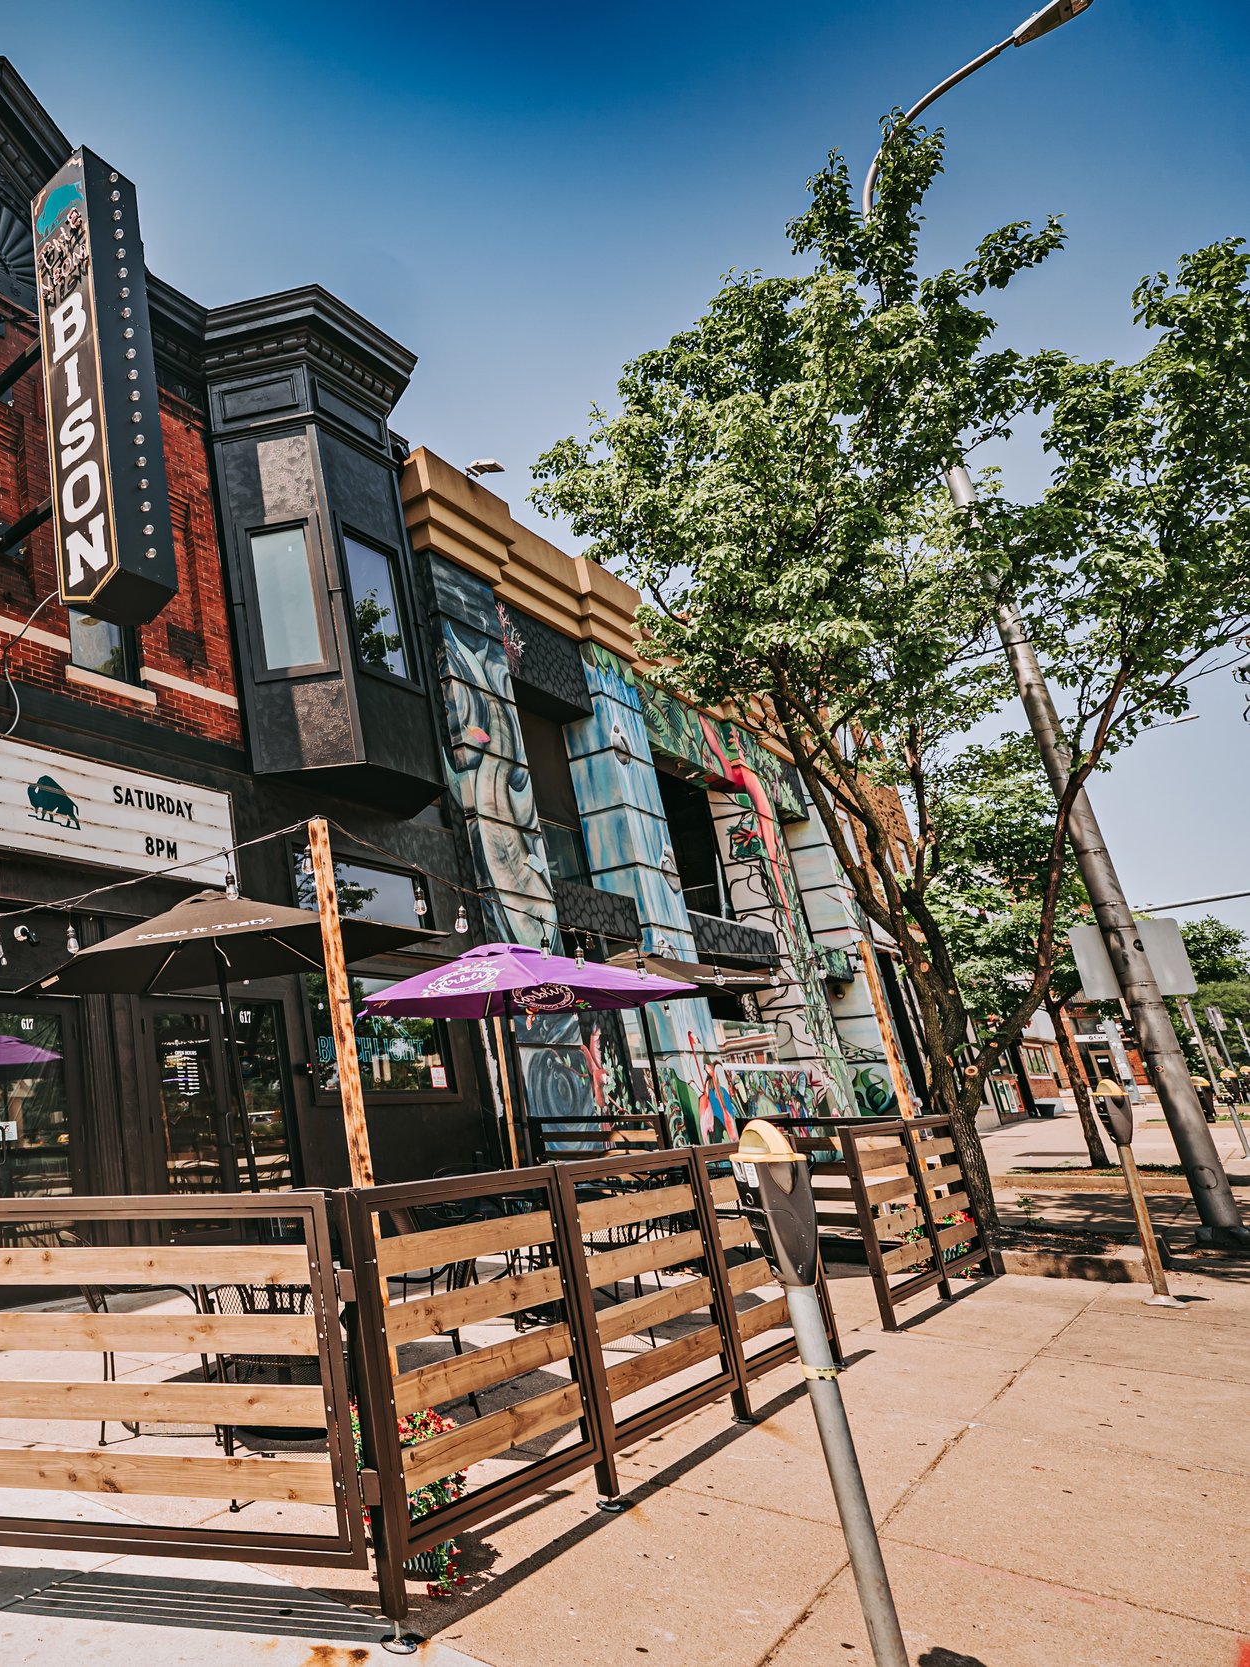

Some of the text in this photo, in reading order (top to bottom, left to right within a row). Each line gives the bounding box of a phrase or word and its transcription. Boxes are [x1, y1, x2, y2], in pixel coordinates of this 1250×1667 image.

[50, 291, 108, 588] BISON
[112, 785, 194, 821] SATURDAY
[145, 836, 178, 861] 8PM
[135, 929, 188, 941] Keep
[190, 926, 208, 934] It
[20, 1018, 34, 1030] 617
[239, 1010, 251, 1024] 617
[372, 1038, 424, 1061] LIGHT
